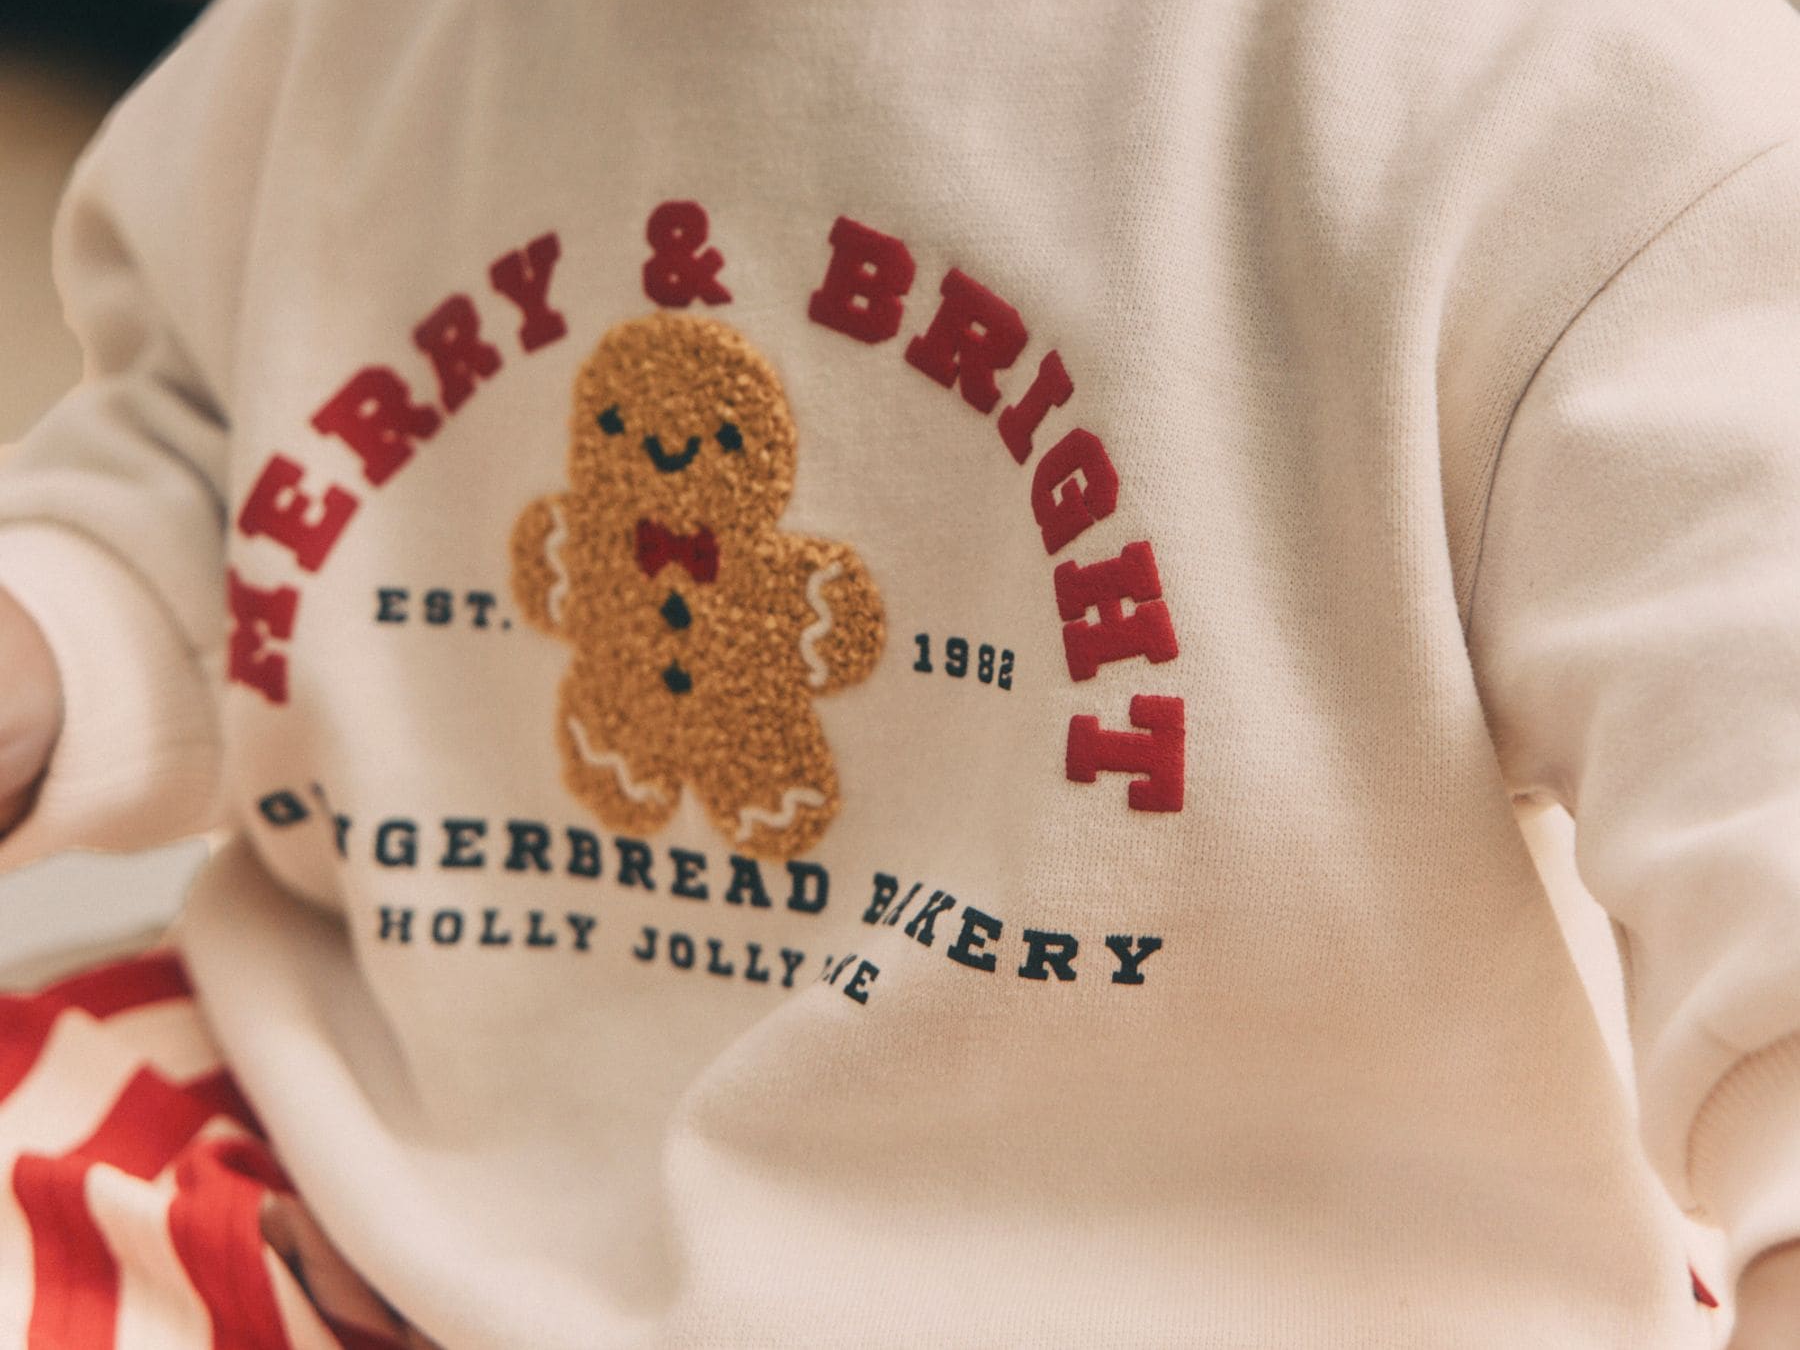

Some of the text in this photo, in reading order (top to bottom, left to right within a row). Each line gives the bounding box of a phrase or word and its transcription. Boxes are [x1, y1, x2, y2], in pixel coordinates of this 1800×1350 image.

[226, 199, 1186, 813] MERRY & BRIGHT
[375, 587, 1015, 691] EST. 1982
[258, 782, 830, 914] GGERBREAD
[379, 906, 597, 952] HOLLY
[633, 925, 806, 988] JOLLY
